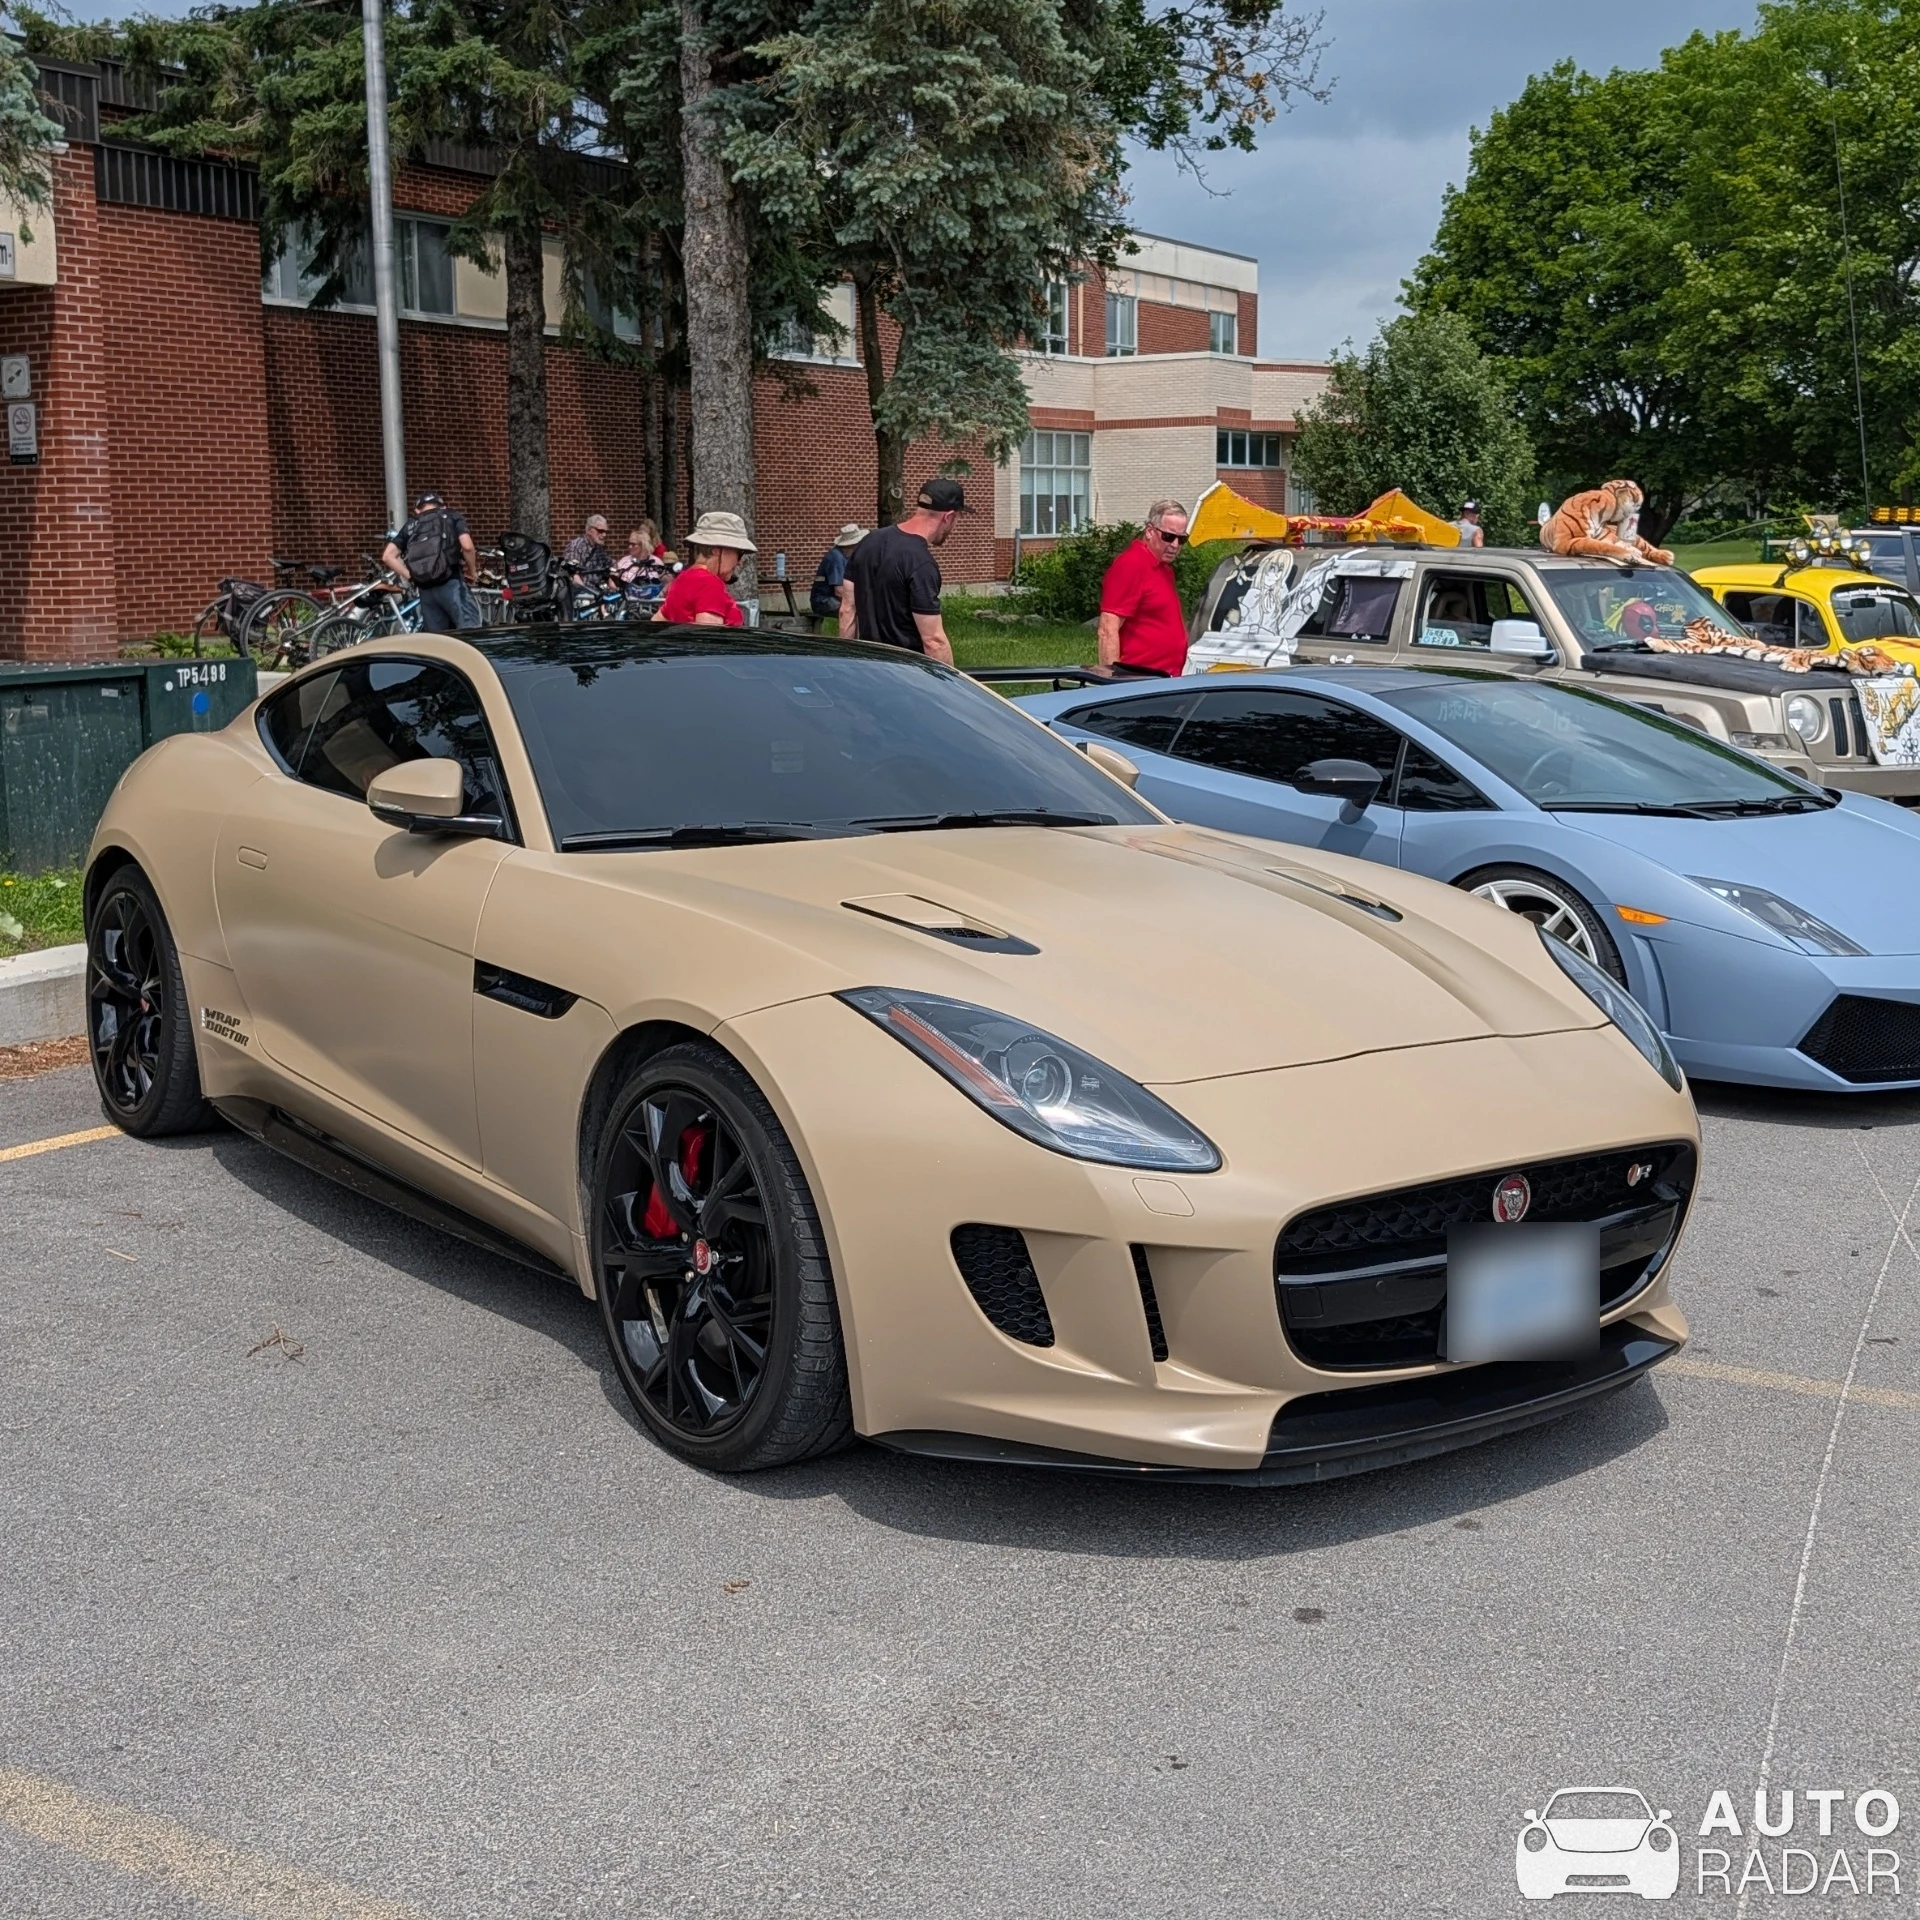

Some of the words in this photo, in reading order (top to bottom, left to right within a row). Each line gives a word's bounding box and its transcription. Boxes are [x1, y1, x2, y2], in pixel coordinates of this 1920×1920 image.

[176, 663, 227, 688] TP5498
[204, 1007, 241, 1027] WRAP
[205, 1019, 250, 1047] DOCTOR
